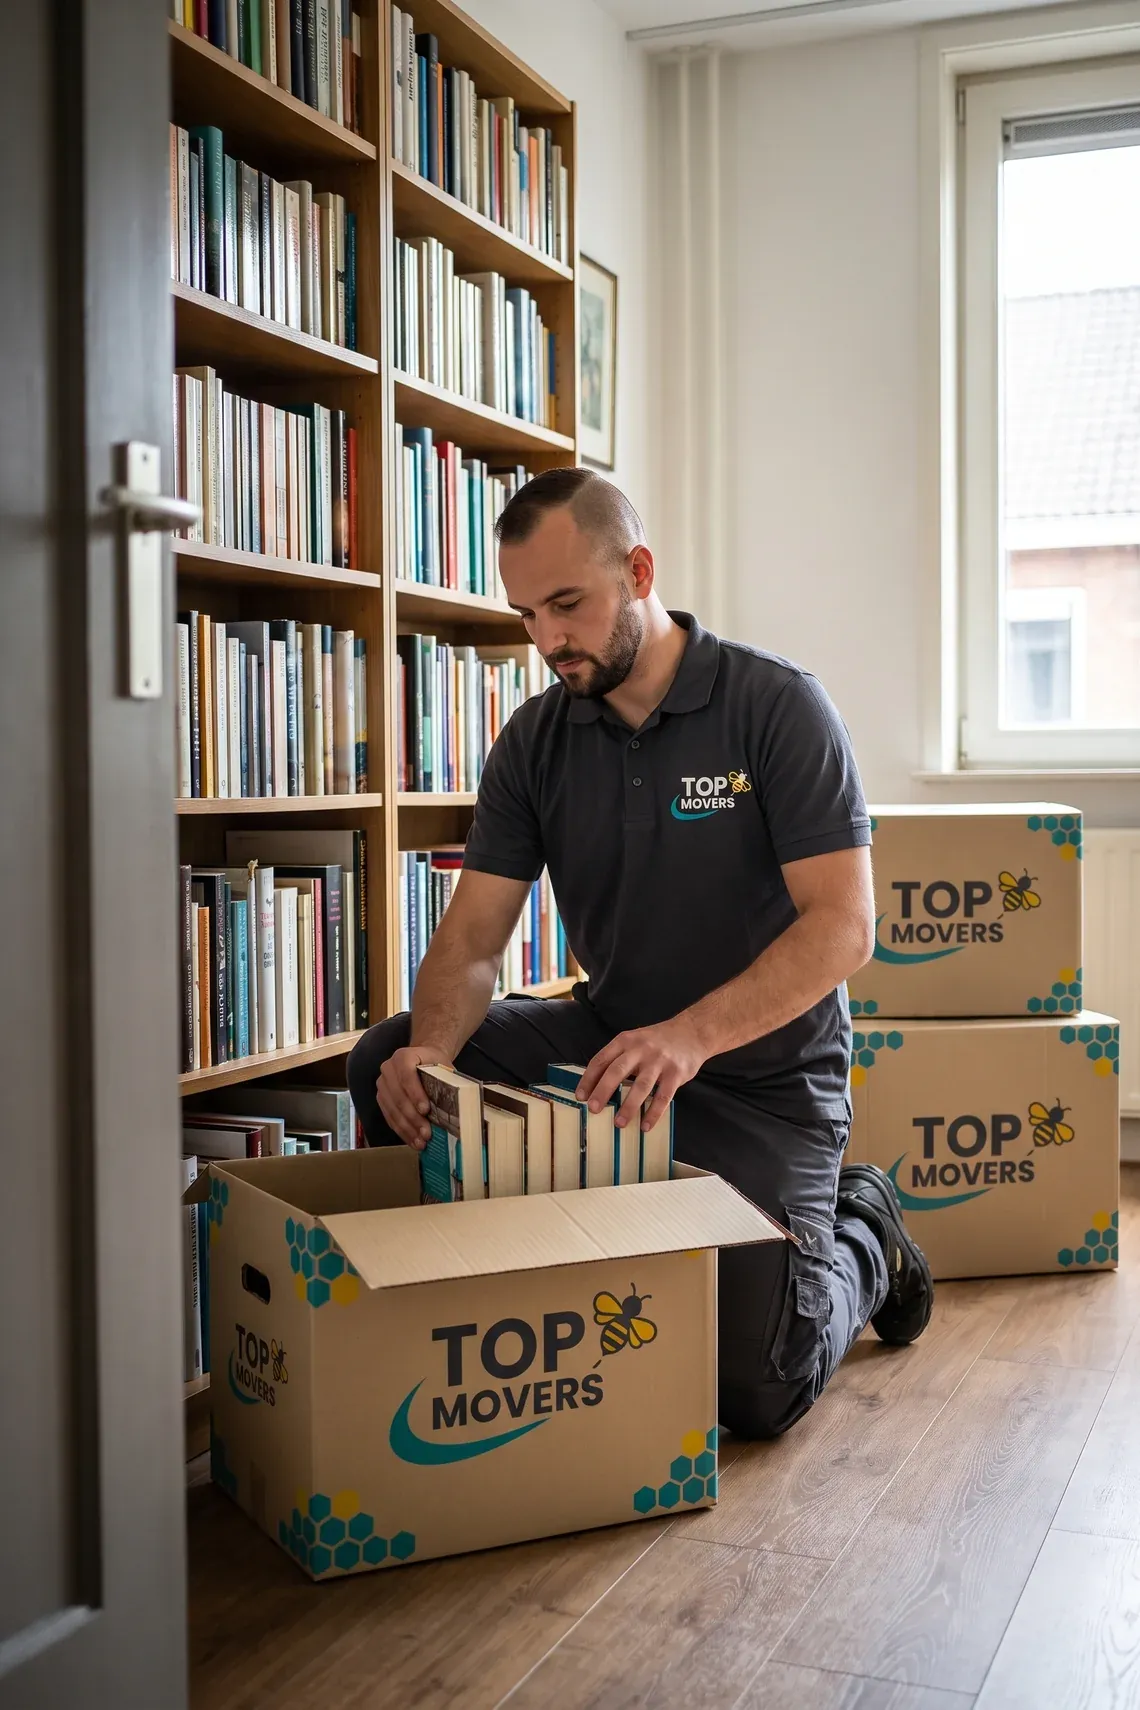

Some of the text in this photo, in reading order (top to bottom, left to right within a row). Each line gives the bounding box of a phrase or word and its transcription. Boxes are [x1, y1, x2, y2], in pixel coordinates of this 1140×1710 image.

[681, 776, 728, 797] TOP
[681, 797, 735, 809] MOVERS
[891, 880, 993, 919] TOP
[891, 922, 1004, 944] MOVERS
[912, 1113, 1022, 1159] TOP
[912, 1159, 1035, 1188] MOVERS
[235, 1323, 269, 1374] TOP
[432, 1310, 585, 1387] TOP
[236, 1361, 276, 1406] MOVERS
[432, 1373, 604, 1431] MOVERS
